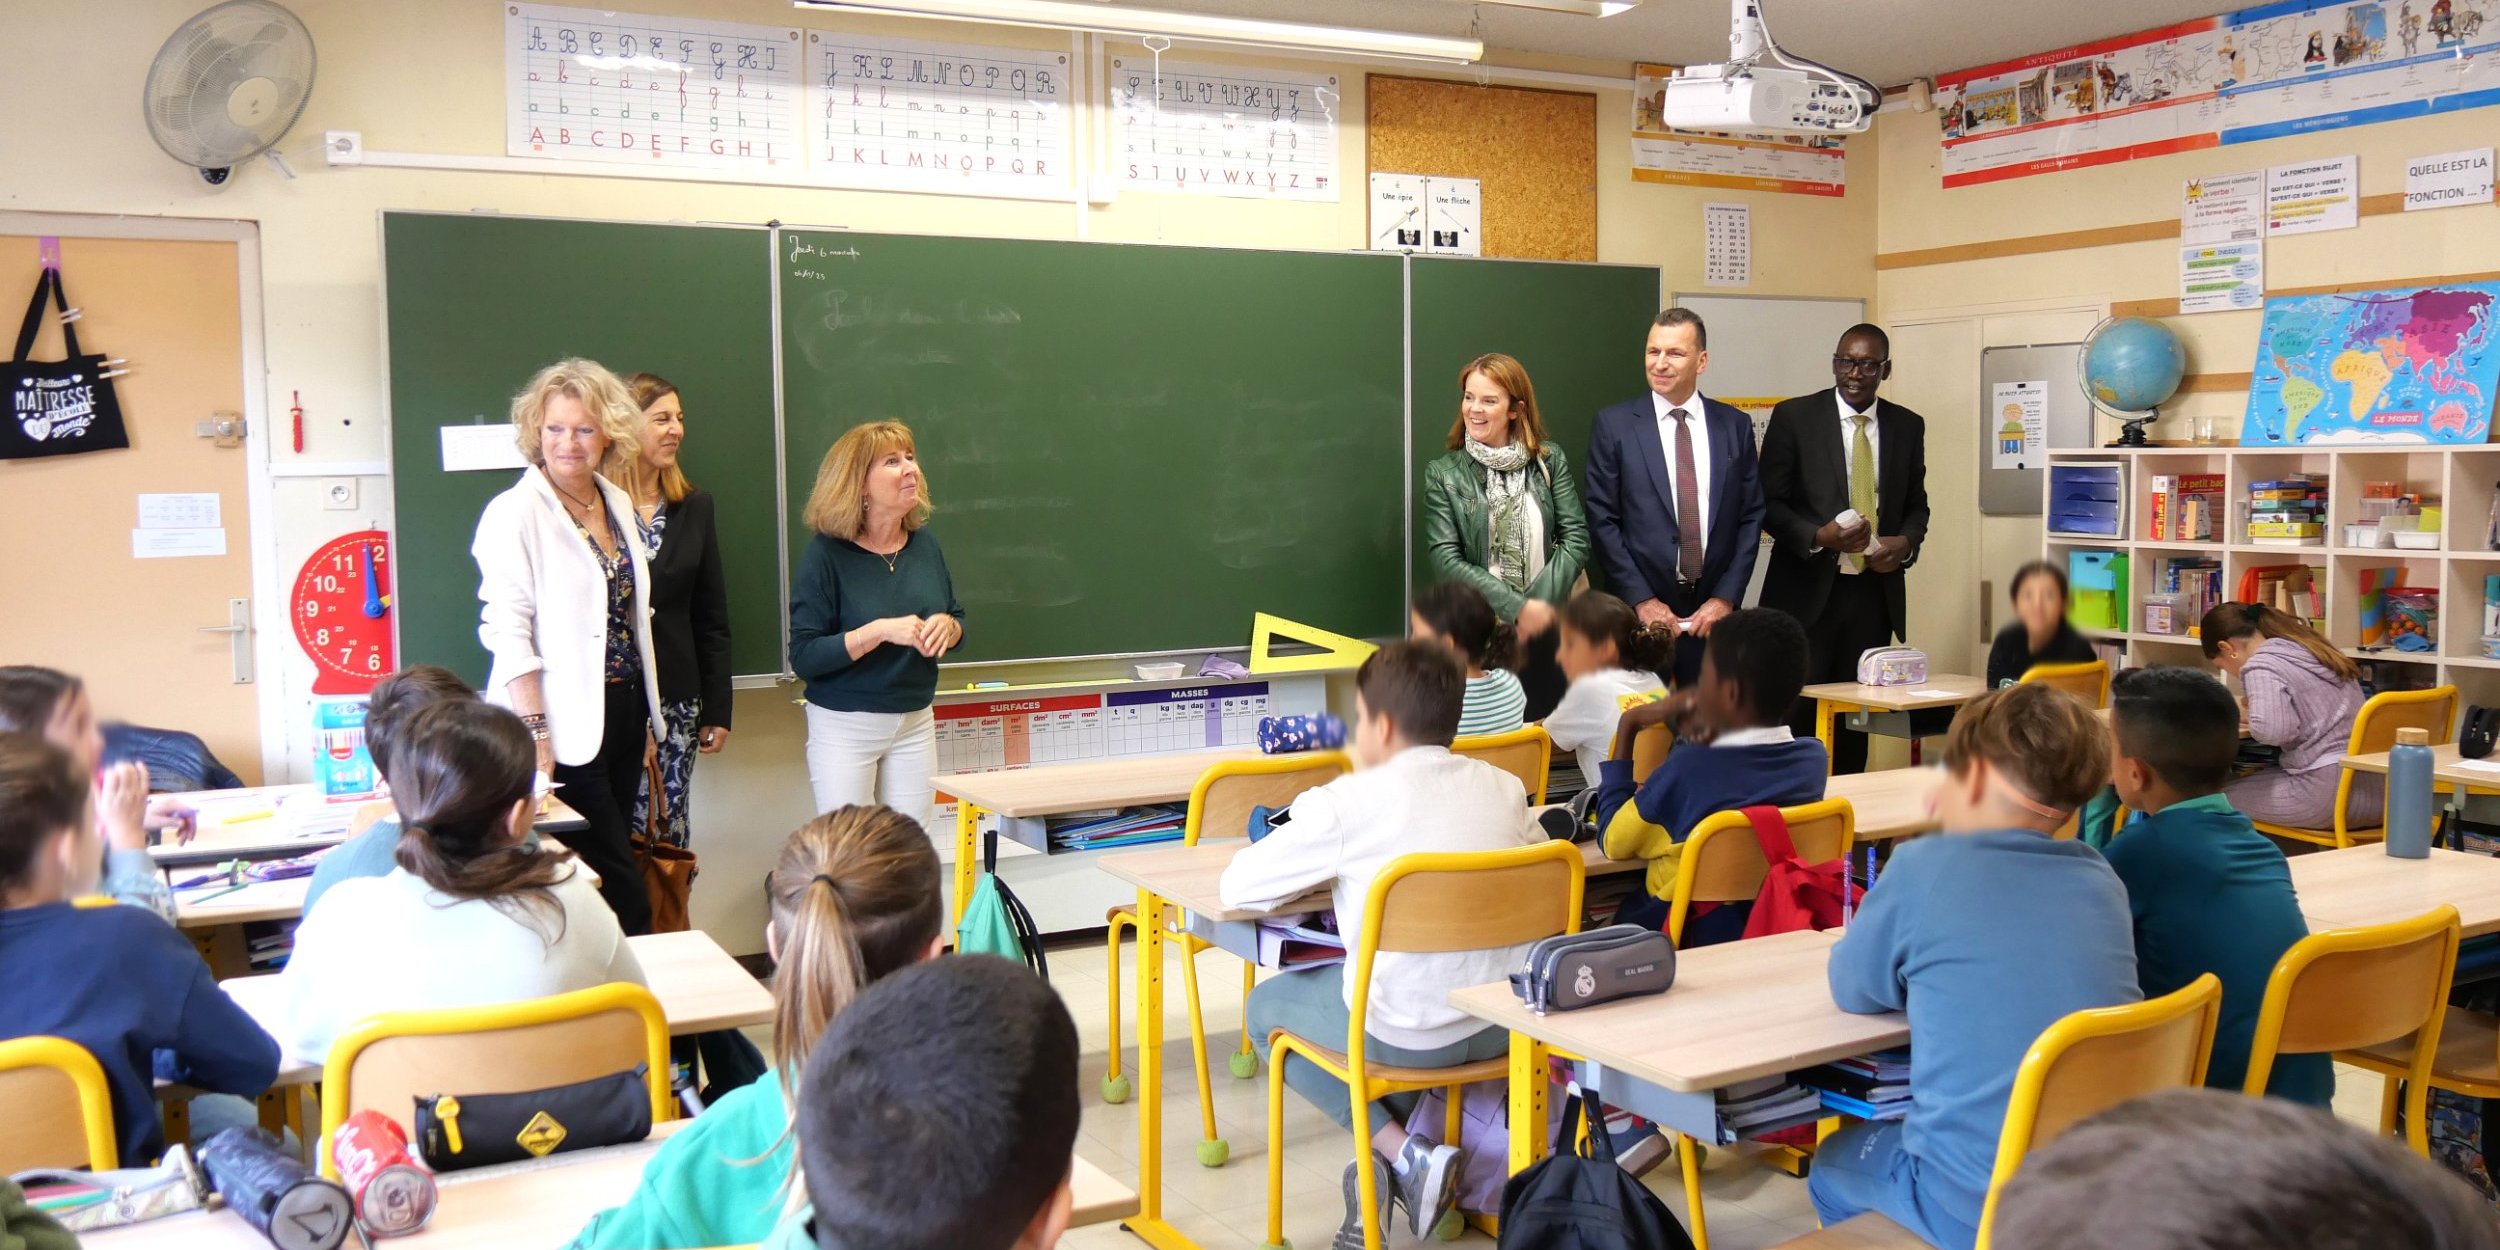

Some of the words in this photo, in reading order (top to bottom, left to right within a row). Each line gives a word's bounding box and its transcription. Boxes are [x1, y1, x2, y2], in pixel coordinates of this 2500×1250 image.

[529, 127, 546, 143] A
[560, 129, 570, 144] B
[591, 131, 604, 147] C
[621, 132, 634, 148] D
[652, 135, 661, 150] E
[681, 137, 689, 152] F
[710, 140, 724, 155] G
[739, 142, 750, 157] H
[828, 147, 834, 161] J
[854, 148, 864, 162] K
[881, 150, 888, 164] L
[908, 152, 923, 168] M
[934, 154, 947, 169] N
[961, 155, 972, 170] O
[986, 157, 994, 171] P
[1012, 159, 1024, 174] Q
[1037, 161, 1045, 175] R
[2290, 167, 2321, 175] FONCTION
[2323, 163, 2342, 171] SUJET
[2410, 162, 2448, 177] QUELLE
[2452, 160, 2470, 171] EST
[2474, 158, 2487, 168] LA
[1129, 165, 1138, 179] S
[1176, 168, 1186, 181] U
[1200, 169, 1209, 182] V
[1223, 170, 1239, 183] W
[1246, 172, 1254, 185] X
[1268, 173, 1276, 185] Y
[1290, 175, 1299, 188] Z
[2409, 188, 2464, 203] FONCTION
[2481, 184, 2486, 194] ?
[820, 248, 827, 257] 6
[15, 385, 96, 411] MAÎTRESSE
[2388, 415, 2419, 423] MONDE
[2179, 480, 2188, 488] Le
[2189, 479, 2208, 488] petit
[2211, 479, 2224, 487] bac
[332, 554, 353, 571] 11
[313, 575, 337, 592] 10
[306, 600, 319, 617] 9
[317, 629, 330, 646] 8
[340, 648, 352, 664] 7
[368, 654, 380, 671] 6
[1171, 689, 1209, 698] MASSES
[990, 701, 1040, 713] SURFACES
